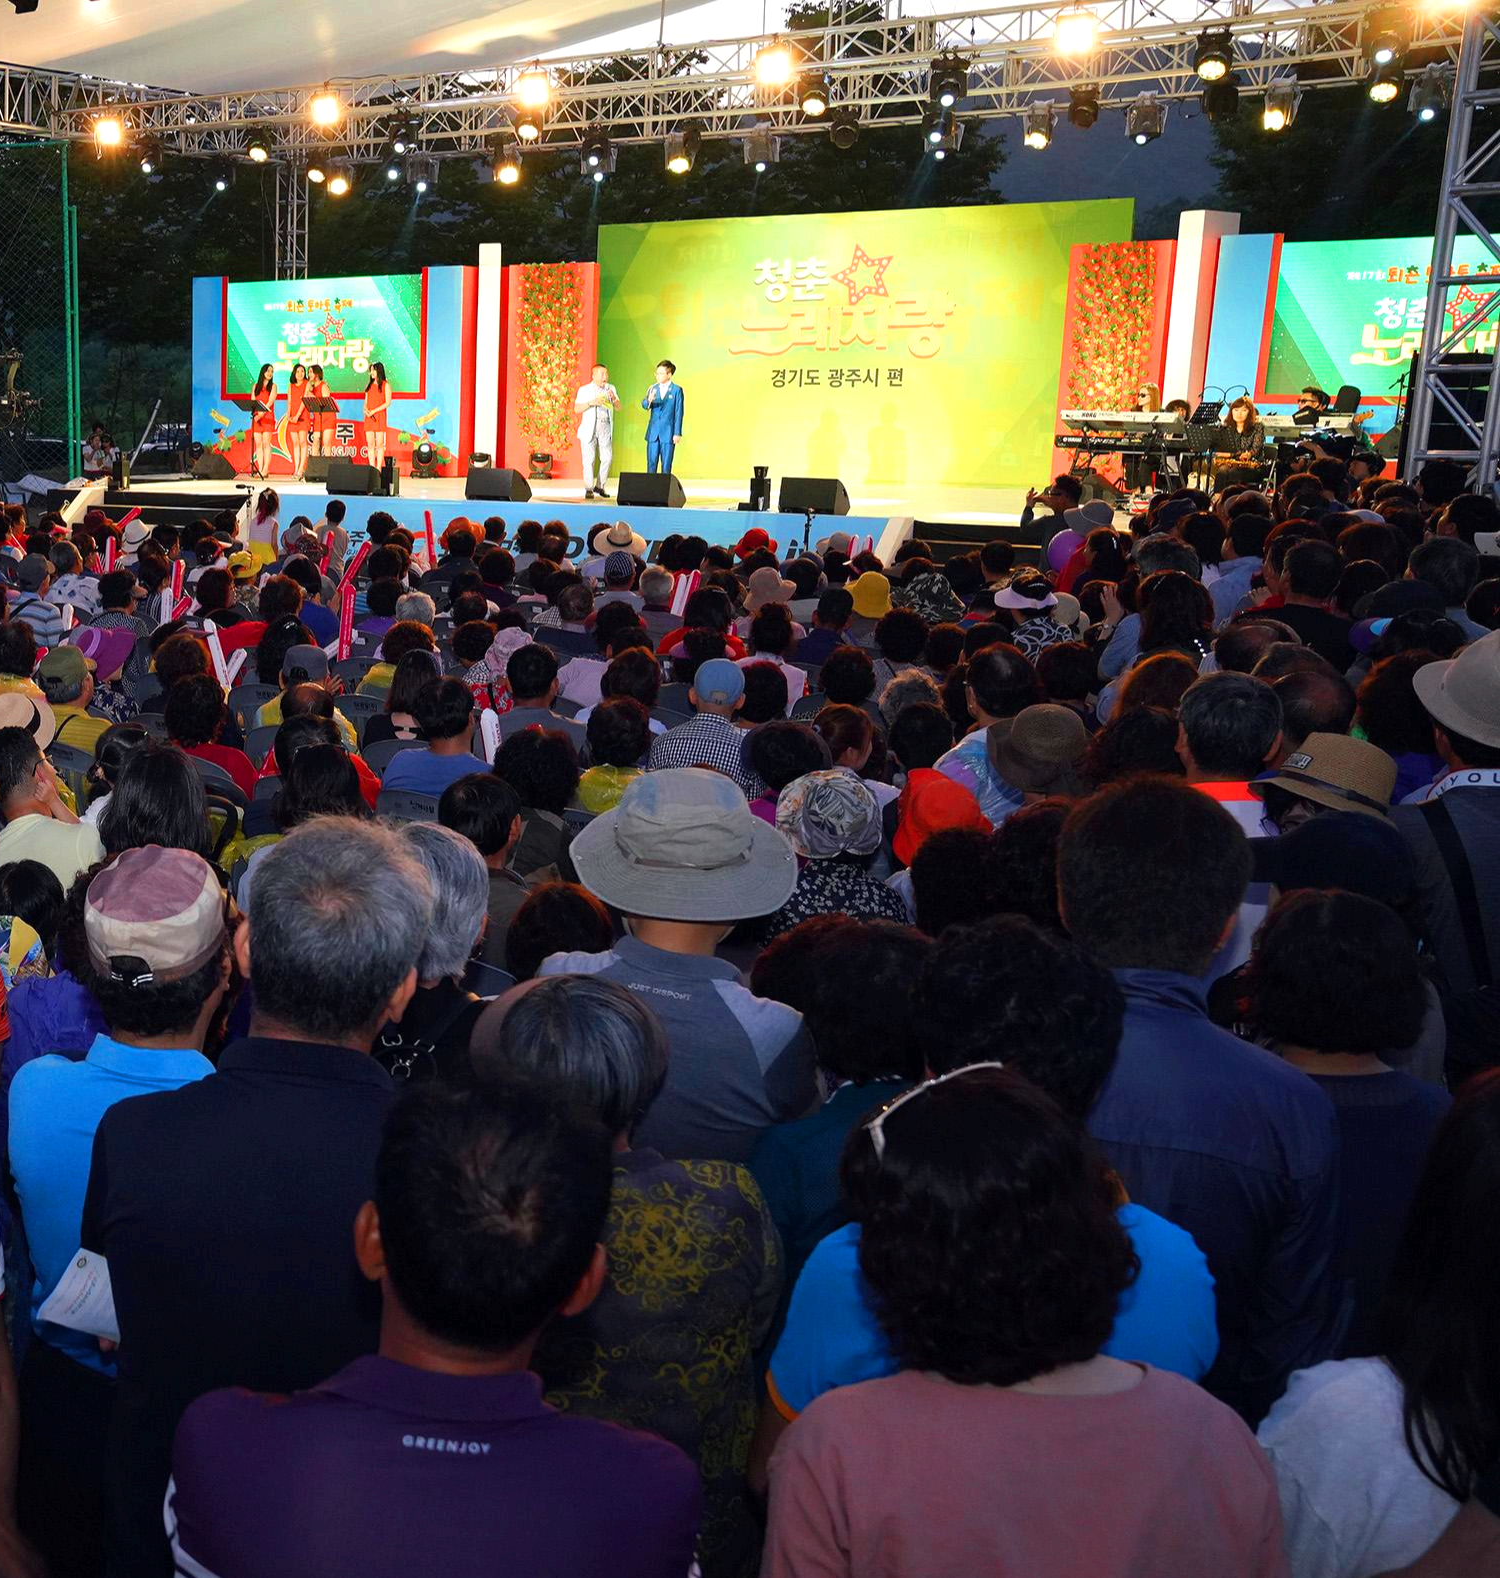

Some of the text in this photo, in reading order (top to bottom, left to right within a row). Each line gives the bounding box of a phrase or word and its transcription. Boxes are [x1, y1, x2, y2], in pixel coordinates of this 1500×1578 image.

[753, 257, 832, 303] 청춘
[281, 321, 318, 345] 청춘
[729, 292, 958, 359] 노래자랑
[274, 338, 375, 374] 노래자랑
[770, 367, 904, 388] 경기도 광주시 편
[627, 982, 651, 992] JUST
[402, 1434, 491, 1455] GREENJOY
